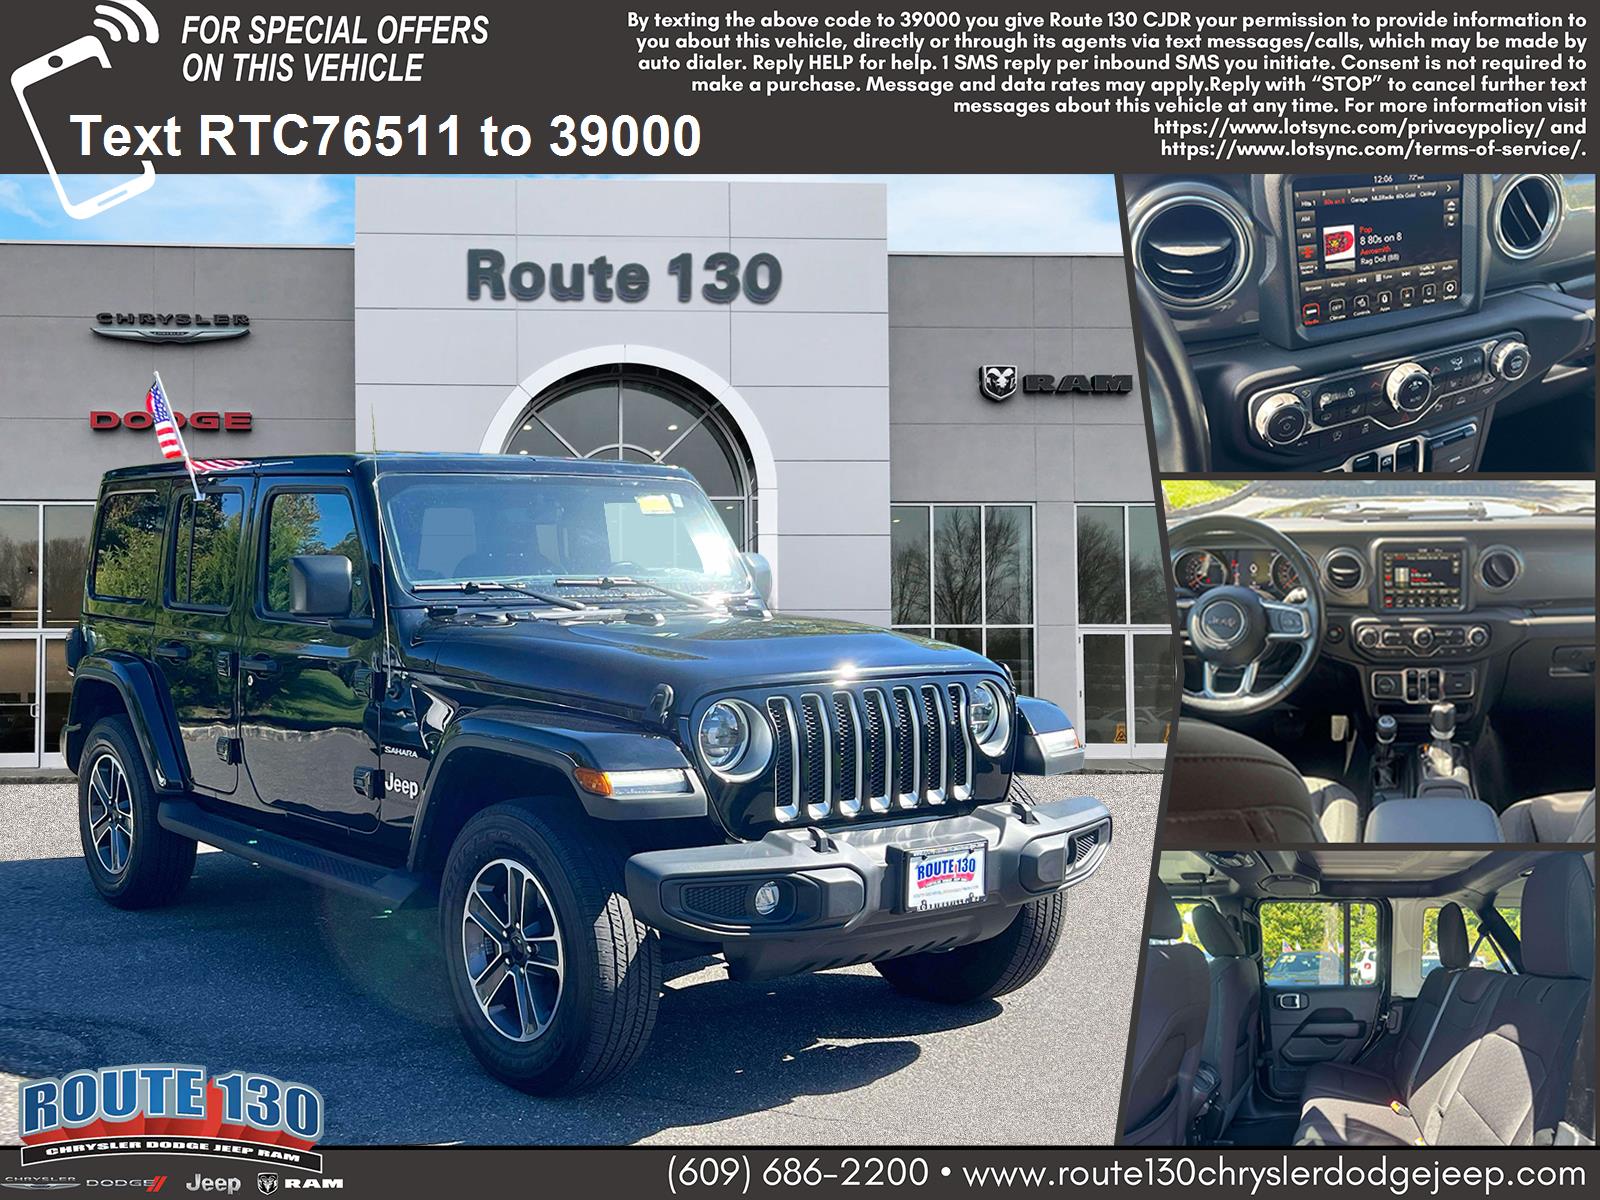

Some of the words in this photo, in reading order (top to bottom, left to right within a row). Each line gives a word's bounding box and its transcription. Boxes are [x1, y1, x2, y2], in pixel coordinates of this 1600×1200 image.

[1374, 175, 1393, 183] 12:06
[1360, 235, 1366, 246] 8
[1367, 234, 1383, 245] 80s
[1384, 234, 1395, 243] on
[1396, 231, 1403, 241] 8
[467, 248, 650, 303] Route
[667, 251, 782, 305] 130
[96, 312, 250, 326] CHRYSLER
[1023, 374, 1133, 393] RAM
[384, 745, 418, 758] SAHARA
[384, 771, 419, 800] Jeep
[917, 859, 954, 881] ROUTE
[956, 858, 976, 873] 130
